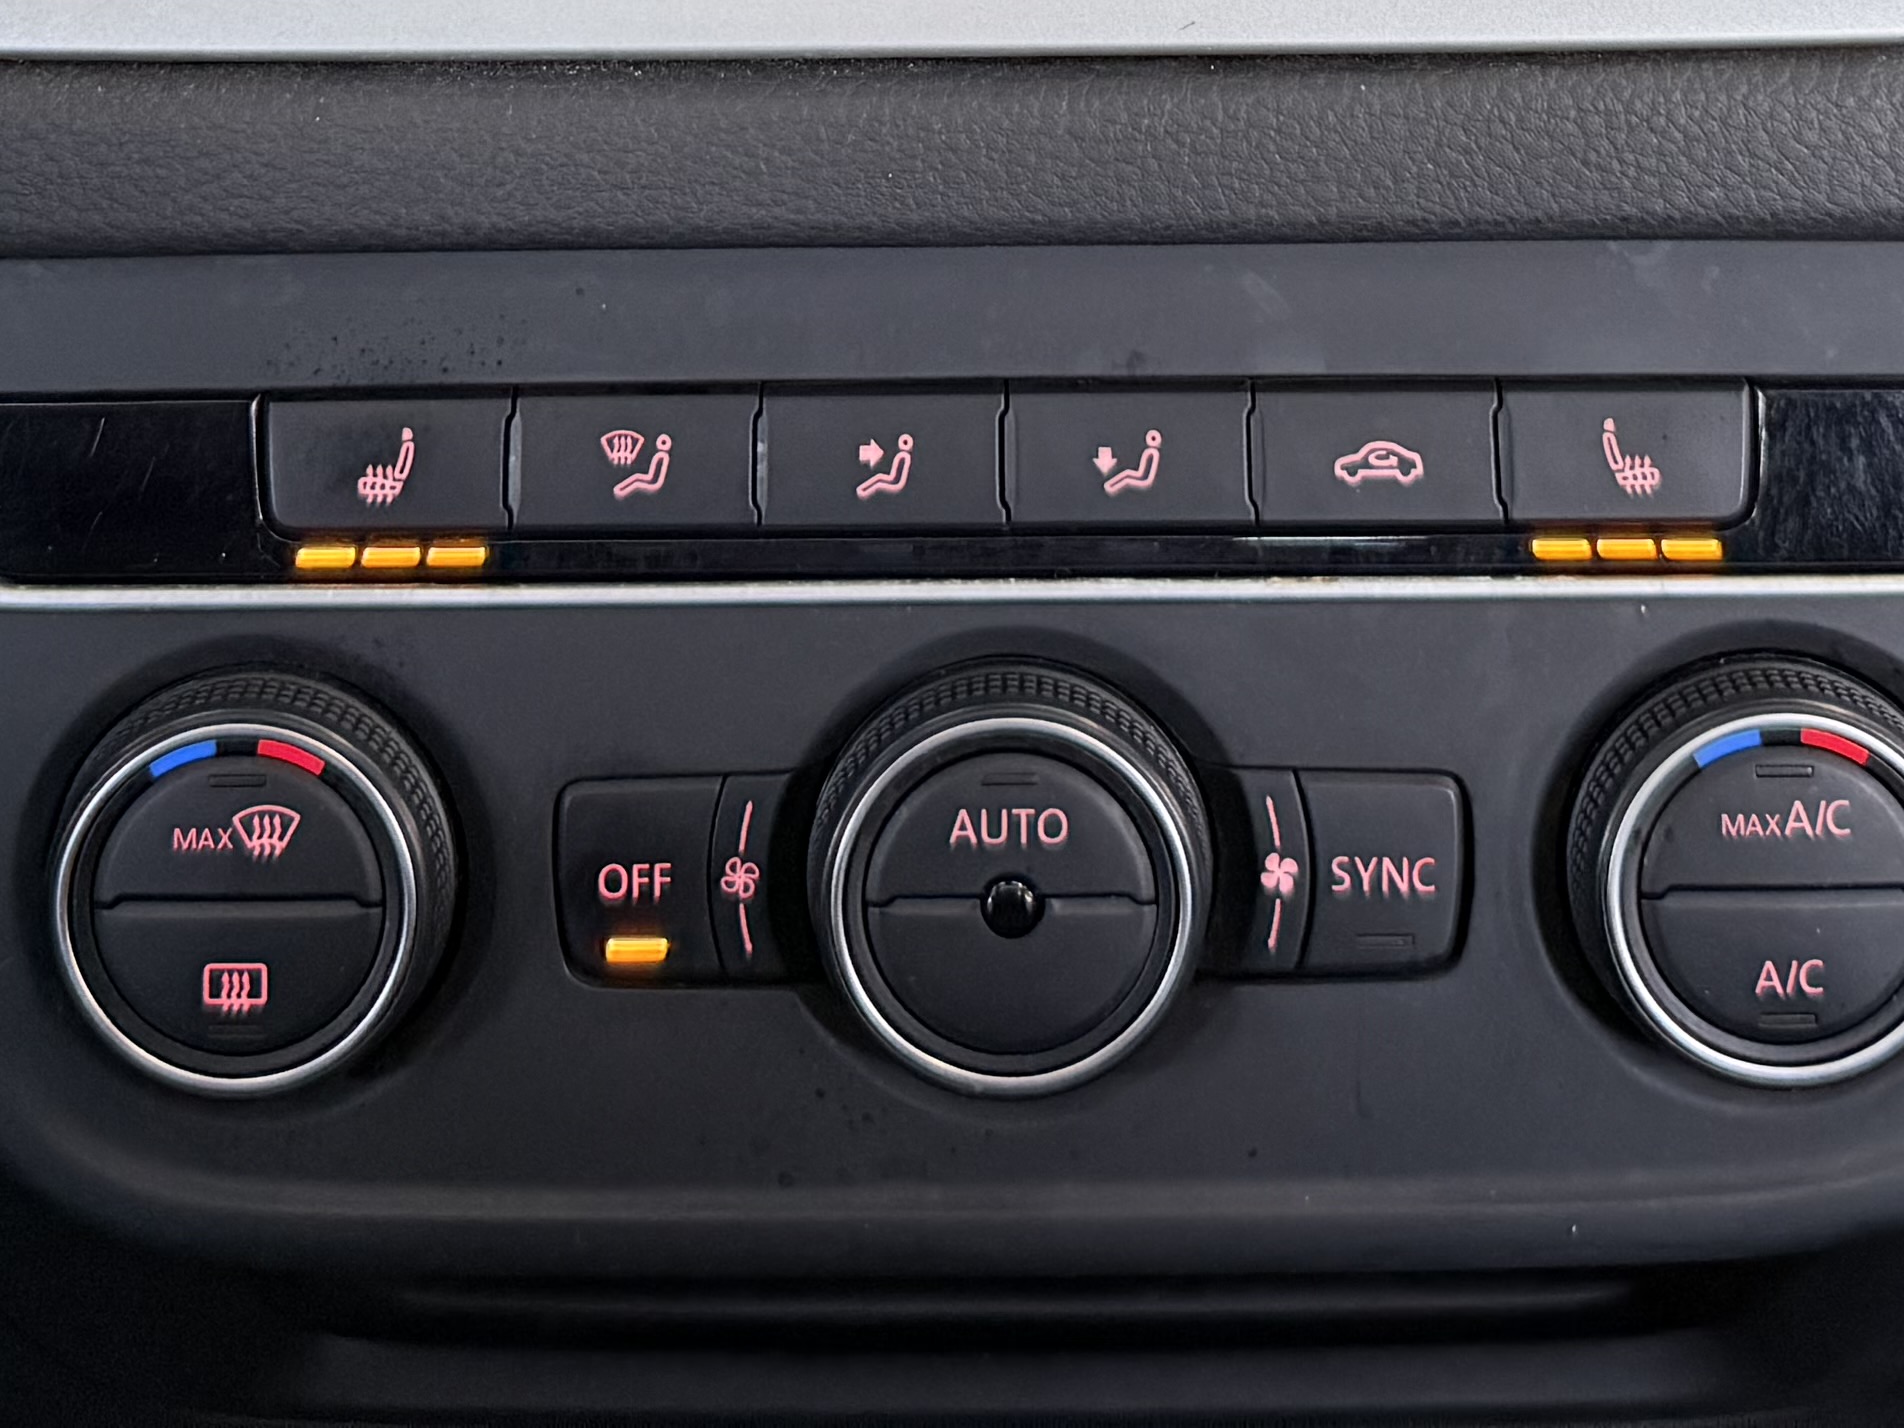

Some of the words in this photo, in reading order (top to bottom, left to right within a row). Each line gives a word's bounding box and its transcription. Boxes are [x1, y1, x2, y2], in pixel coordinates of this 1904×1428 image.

[171, 826, 234, 853] MAX
[948, 807, 1069, 847] AUTO
[598, 863, 673, 901] OFF
[1330, 855, 1437, 896] SYNC
[1754, 958, 1825, 996] A/C
